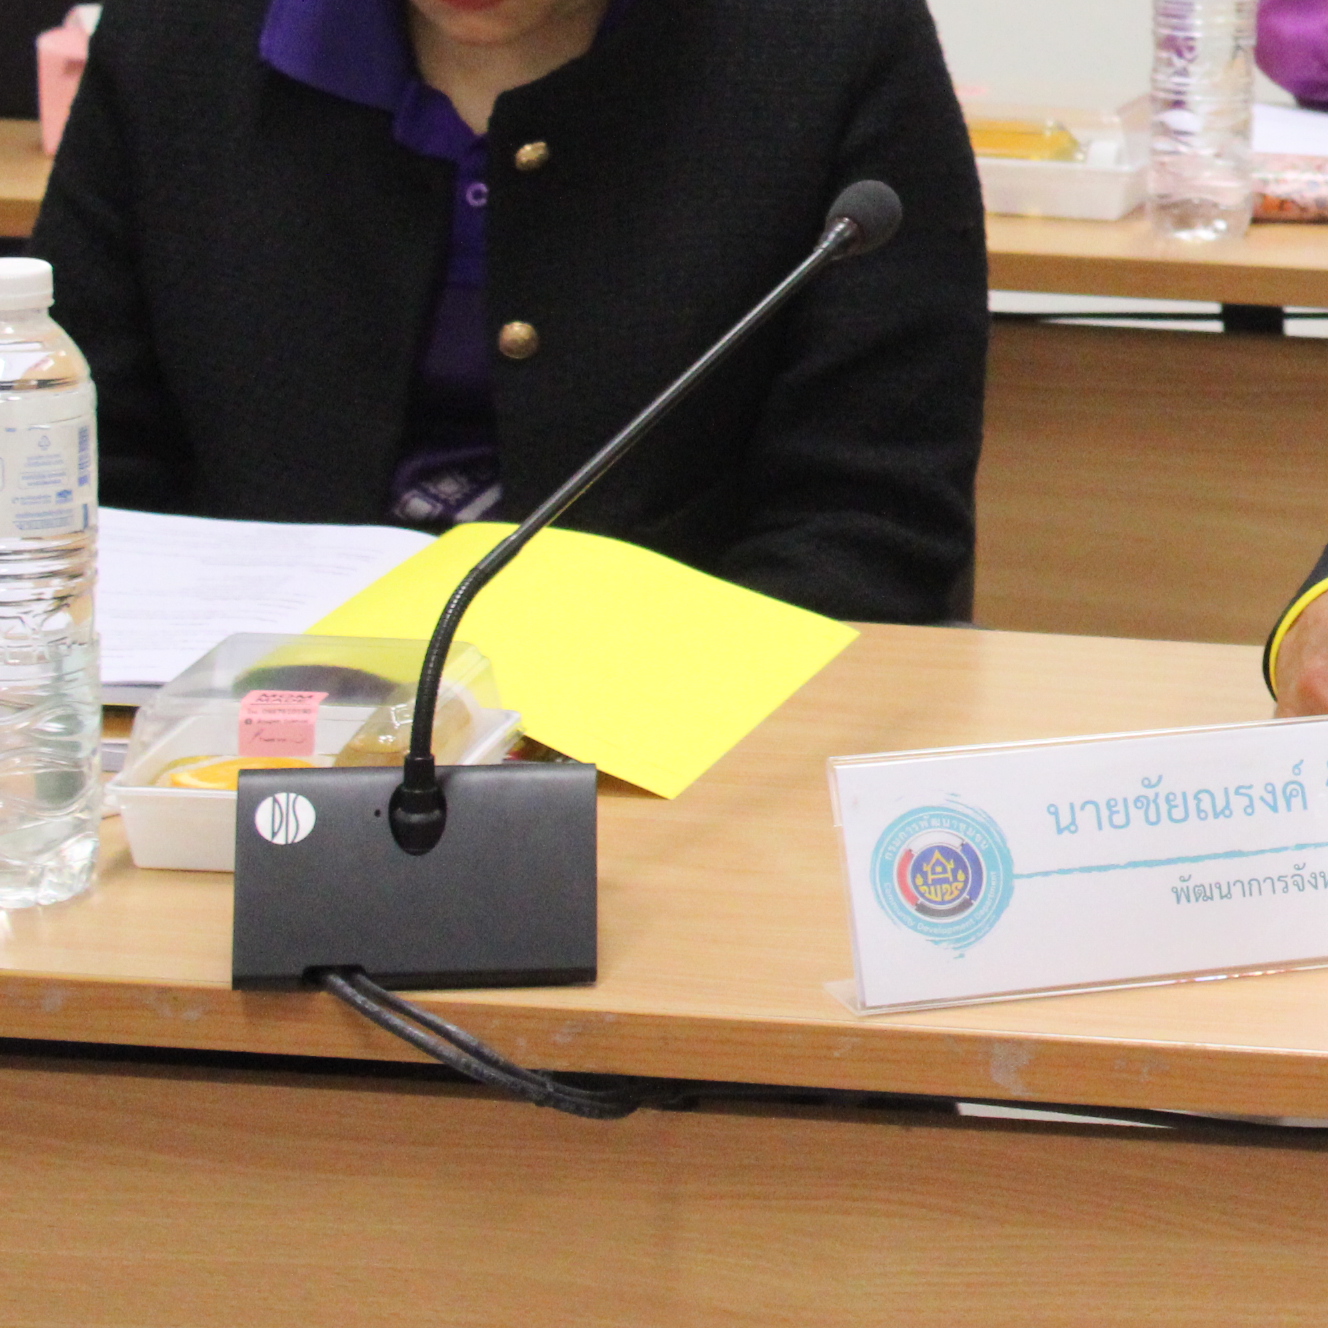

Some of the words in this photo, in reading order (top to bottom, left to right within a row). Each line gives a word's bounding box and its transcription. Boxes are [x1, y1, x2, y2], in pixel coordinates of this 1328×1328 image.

[1046, 758, 1309, 836] นายชัยณรงค์
